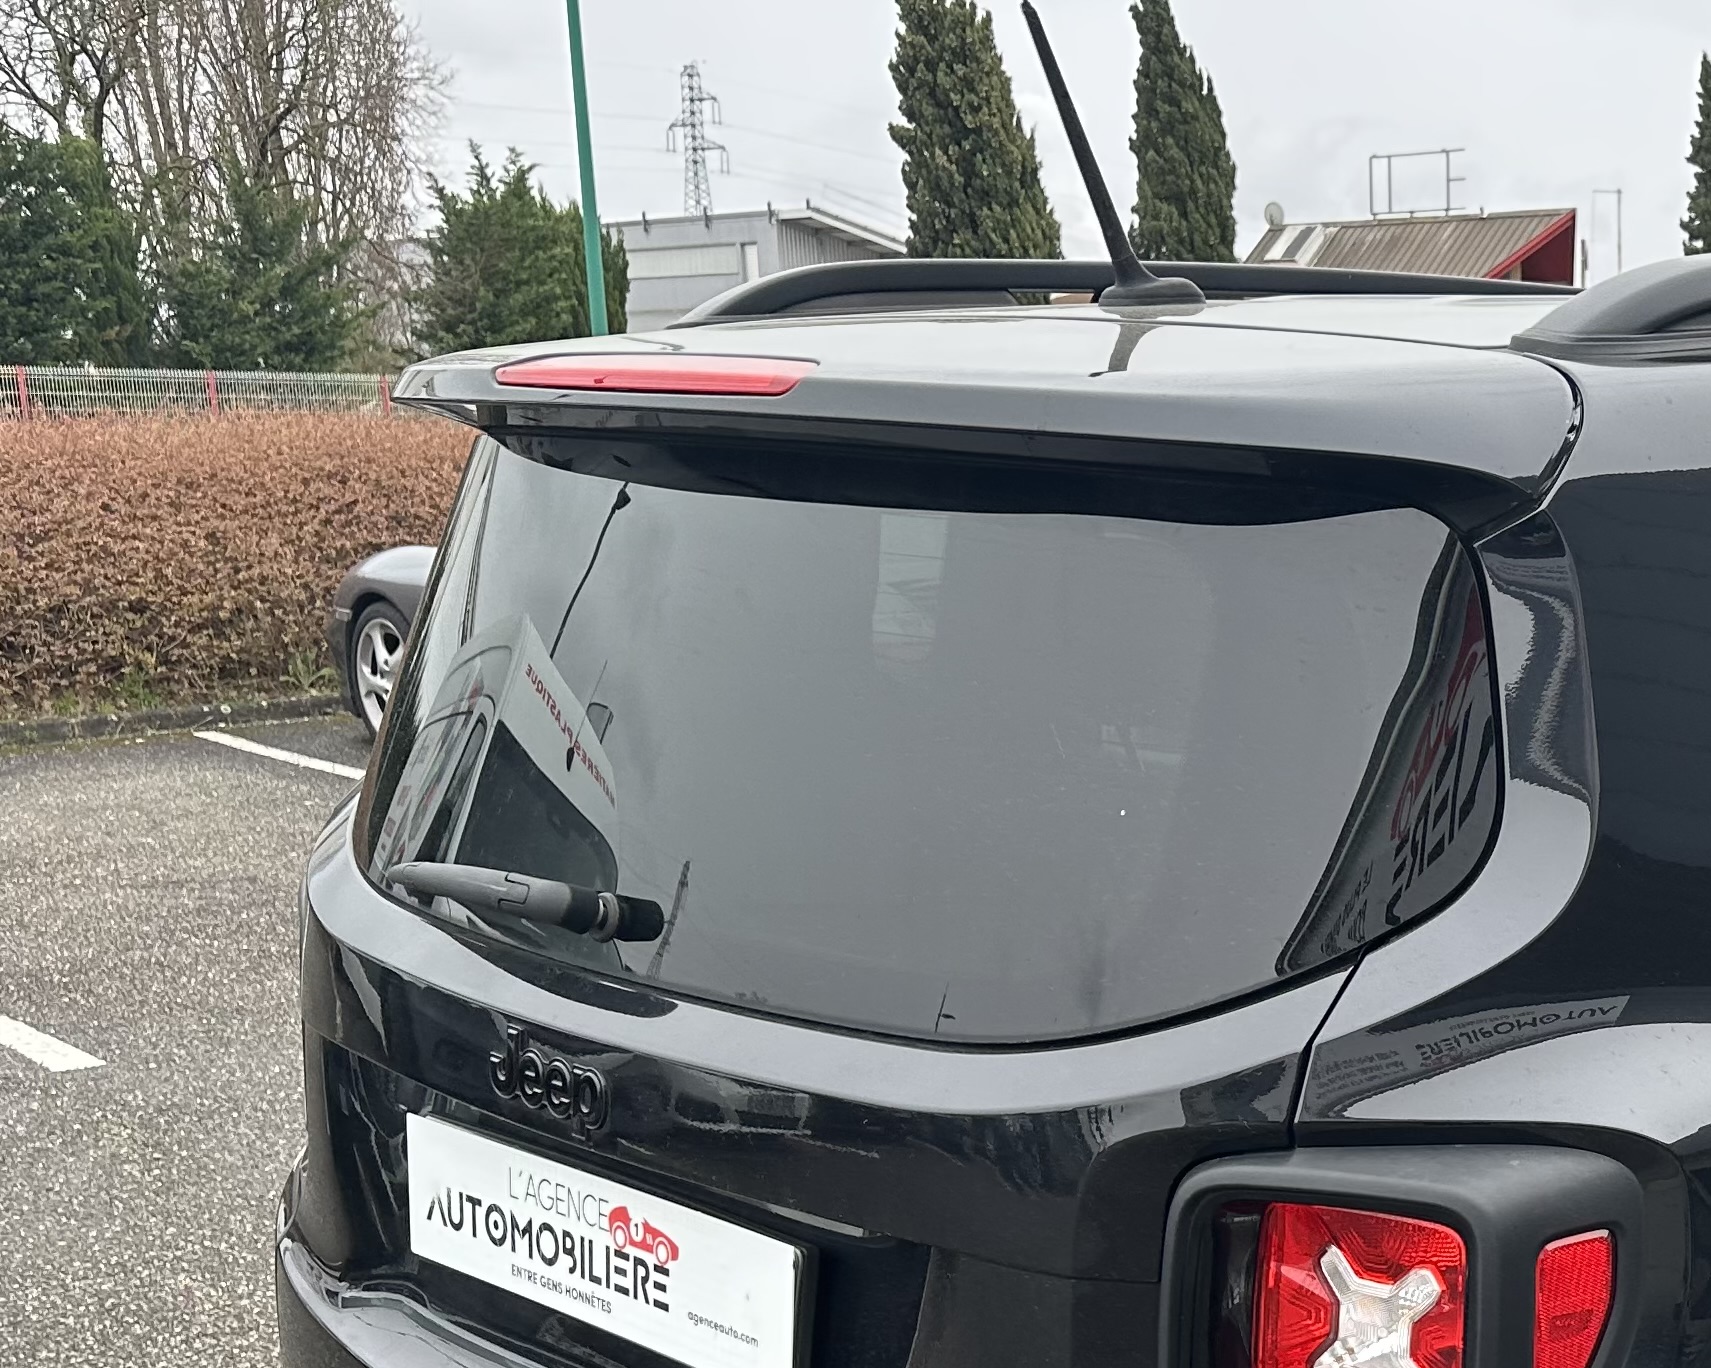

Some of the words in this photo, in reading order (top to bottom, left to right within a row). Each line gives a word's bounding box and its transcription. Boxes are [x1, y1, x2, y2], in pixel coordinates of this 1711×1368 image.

[489, 1023, 611, 1143] Jeep
[508, 1167, 610, 1233] L'AGENCE
[511, 1263, 538, 1286] ENTRE
[540, 1275, 563, 1295] GENS
[565, 1286, 612, 1314] HONNÊTES
[687, 1310, 759, 1348] agenceauto.com
